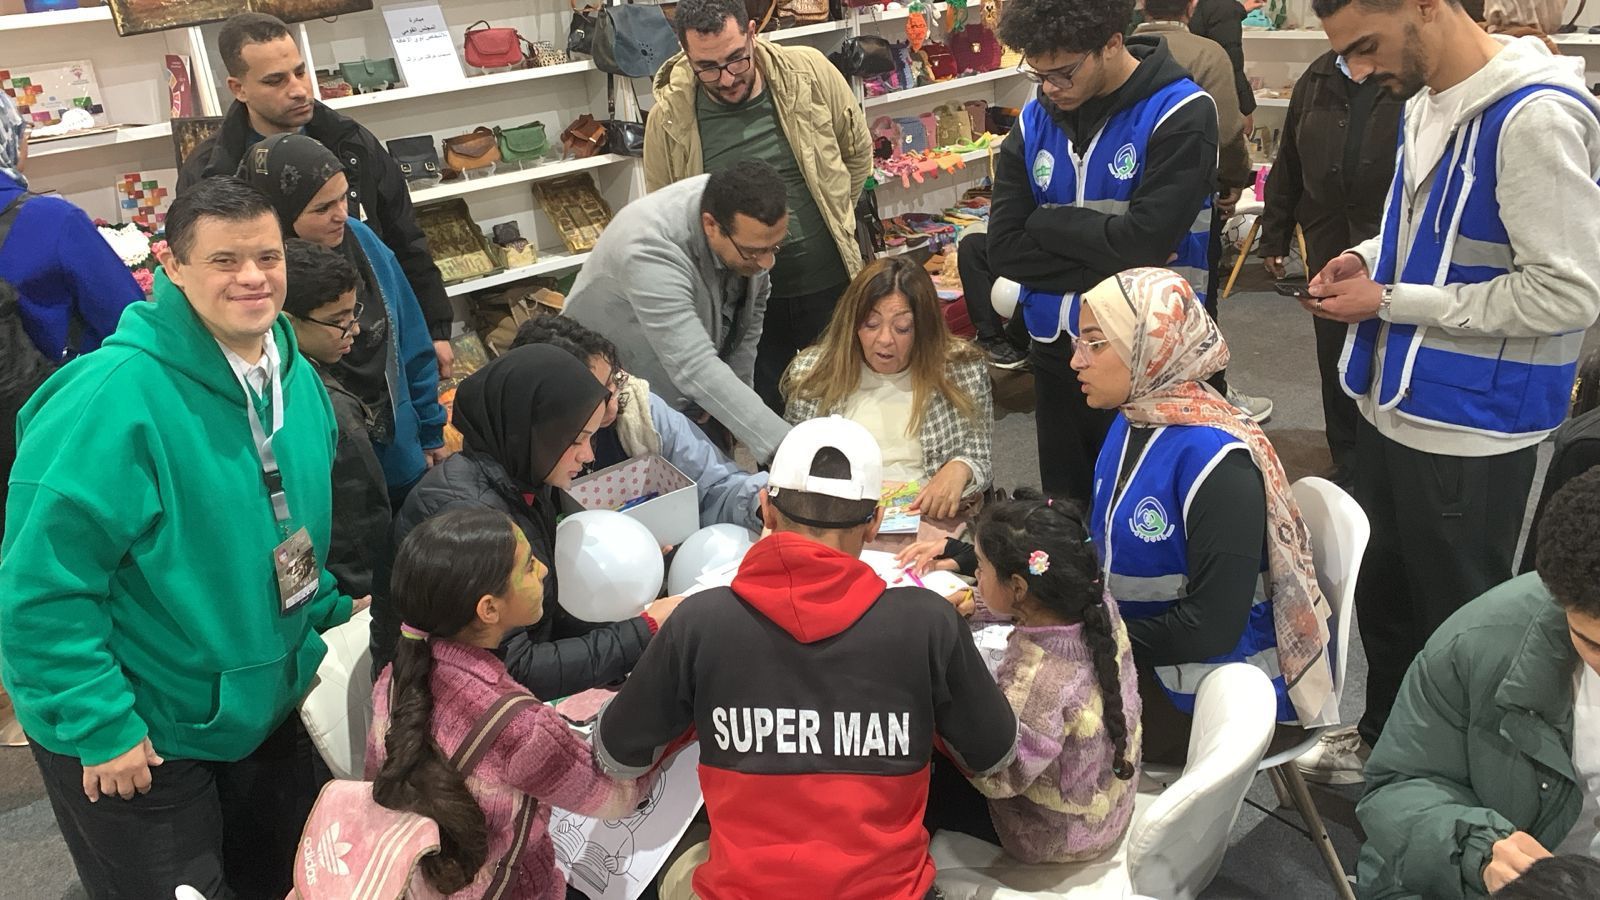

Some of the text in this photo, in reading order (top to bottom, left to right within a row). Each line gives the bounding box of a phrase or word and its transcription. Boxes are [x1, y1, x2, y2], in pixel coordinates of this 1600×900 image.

[712, 706, 910, 756] SUPER MAN
[304, 836, 317, 886] adidas
